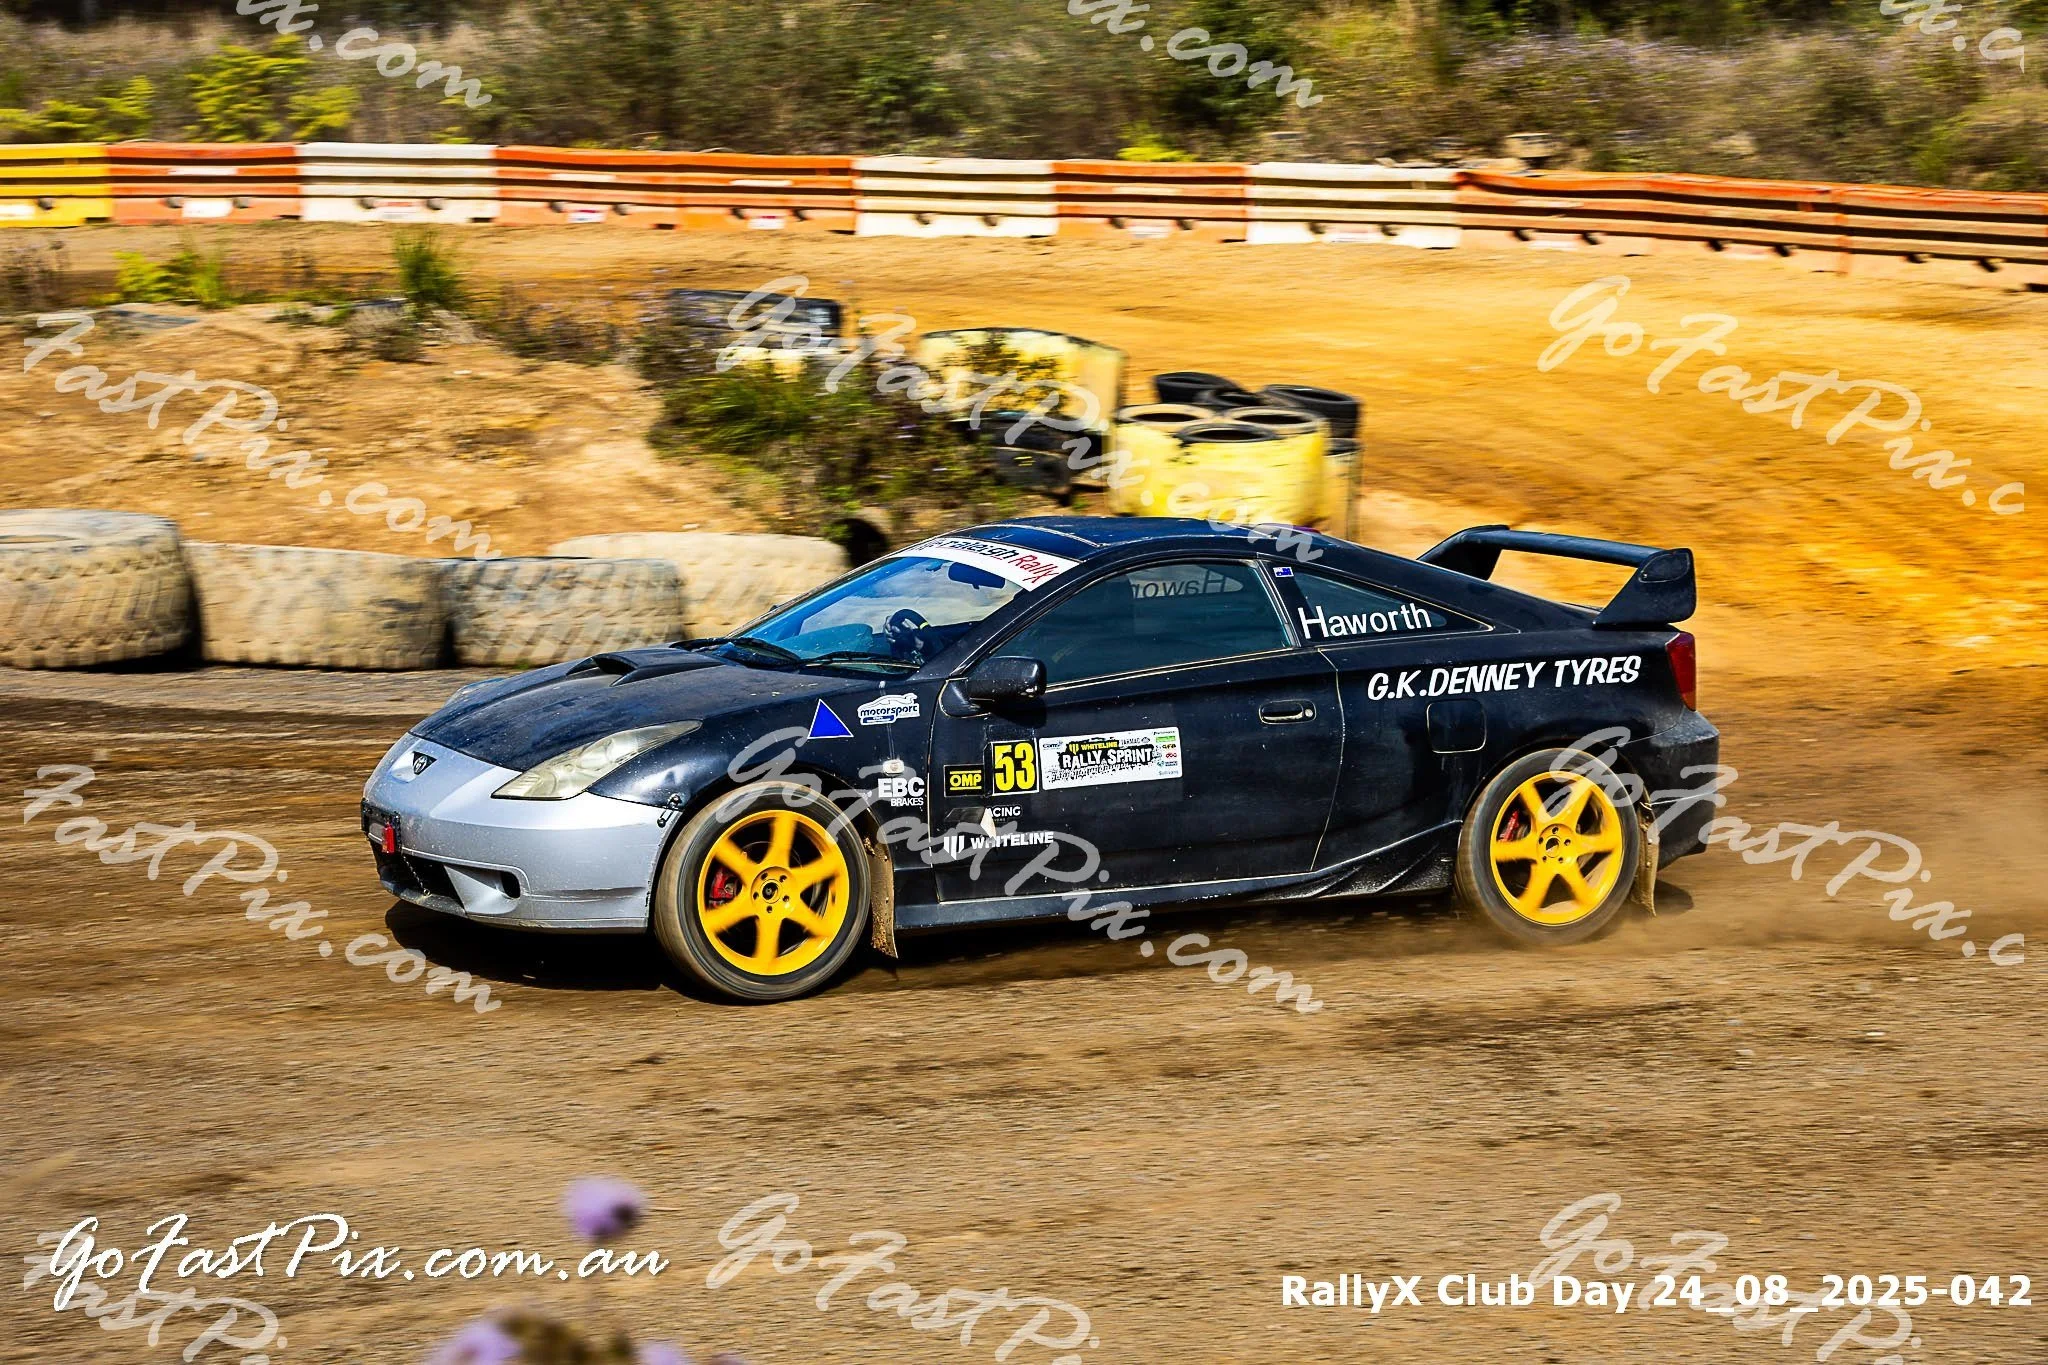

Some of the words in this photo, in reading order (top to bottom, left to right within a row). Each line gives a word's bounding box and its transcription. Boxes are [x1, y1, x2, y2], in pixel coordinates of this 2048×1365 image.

[1298, 603, 1432, 639] Haworth
[1554, 655, 1641, 688] TYRES
[860, 705, 918, 717] motorsport
[1081, 741, 1118, 751] WHITELINE
[994, 742, 1036, 791] 53
[1062, 750, 1103, 771] RALLY
[1107, 748, 1153, 765] SPRINT
[878, 777, 925, 798] EBC
[950, 774, 982, 787] OMP
[890, 797, 924, 807] BRAKES
[970, 831, 1055, 849] WHITELINE
